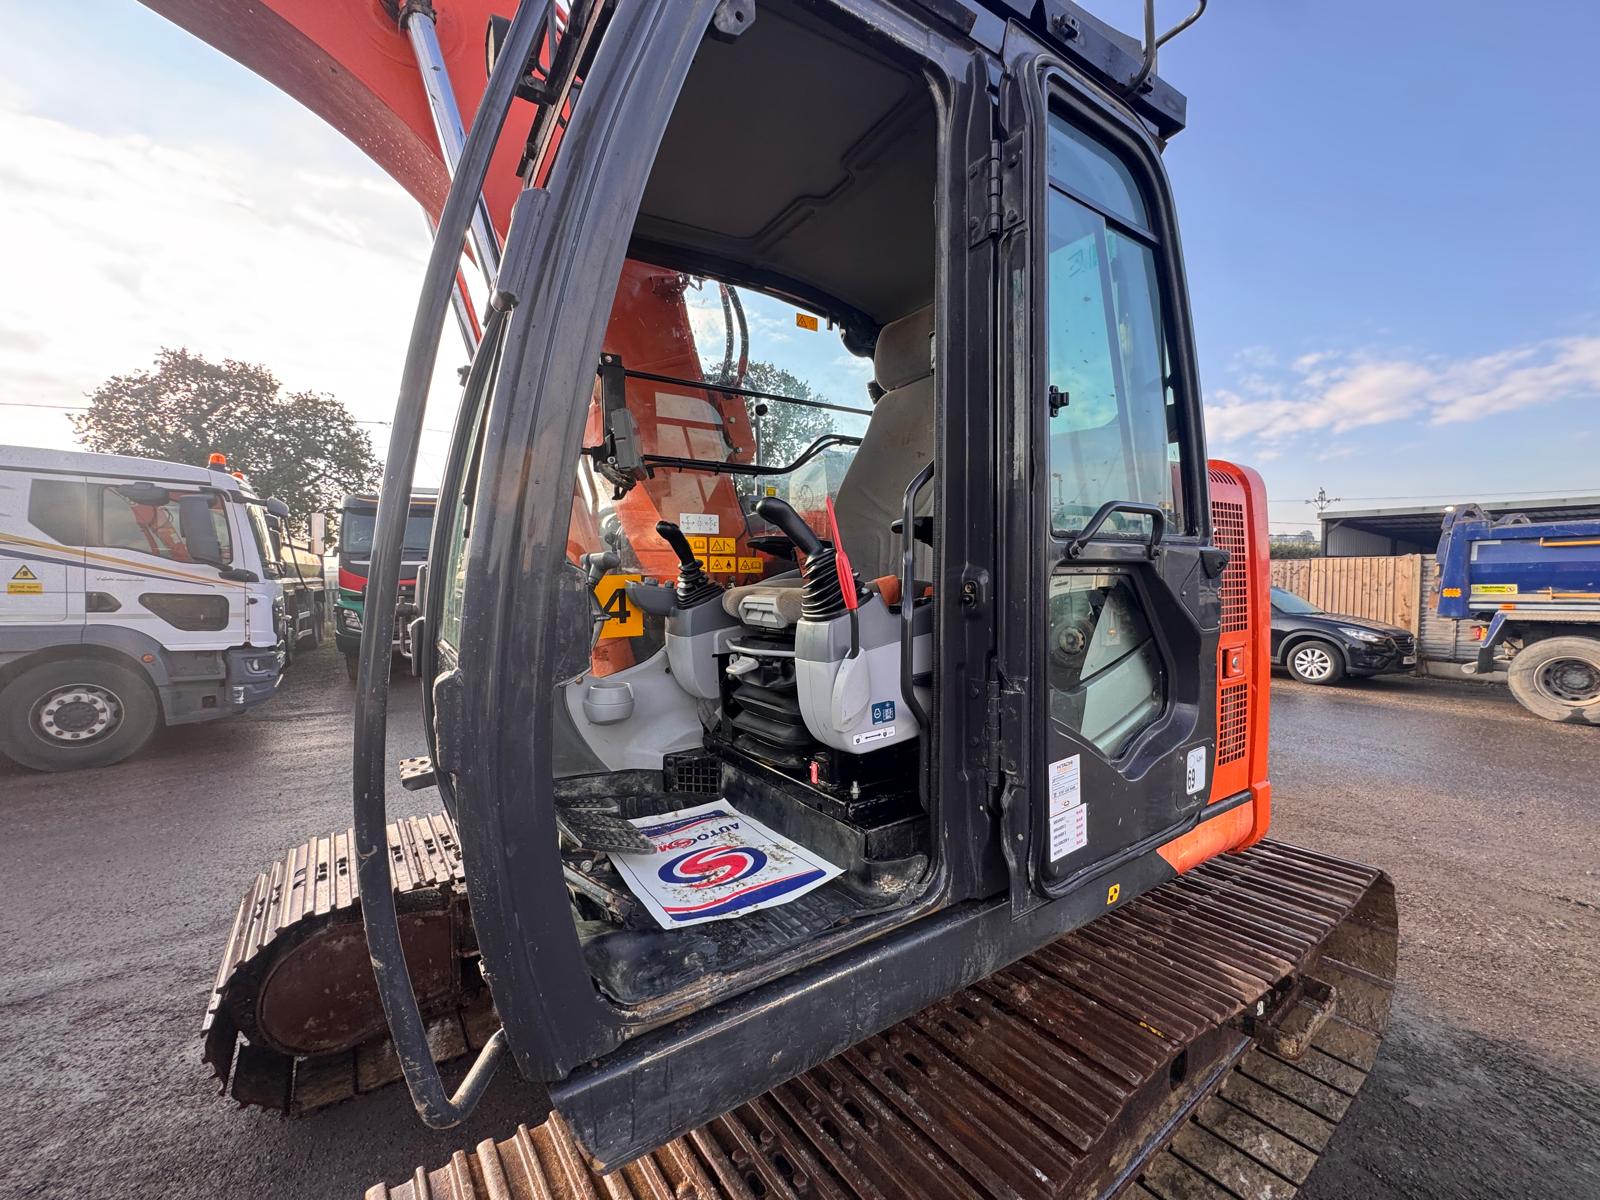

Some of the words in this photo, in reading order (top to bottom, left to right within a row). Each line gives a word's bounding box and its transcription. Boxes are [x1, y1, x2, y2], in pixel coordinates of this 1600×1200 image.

[603, 588, 631, 624] 4
[1056, 759, 1073, 769] HITACHI
[1187, 767, 1196, 791] 69
[655, 821, 741, 853] AUTOSM
